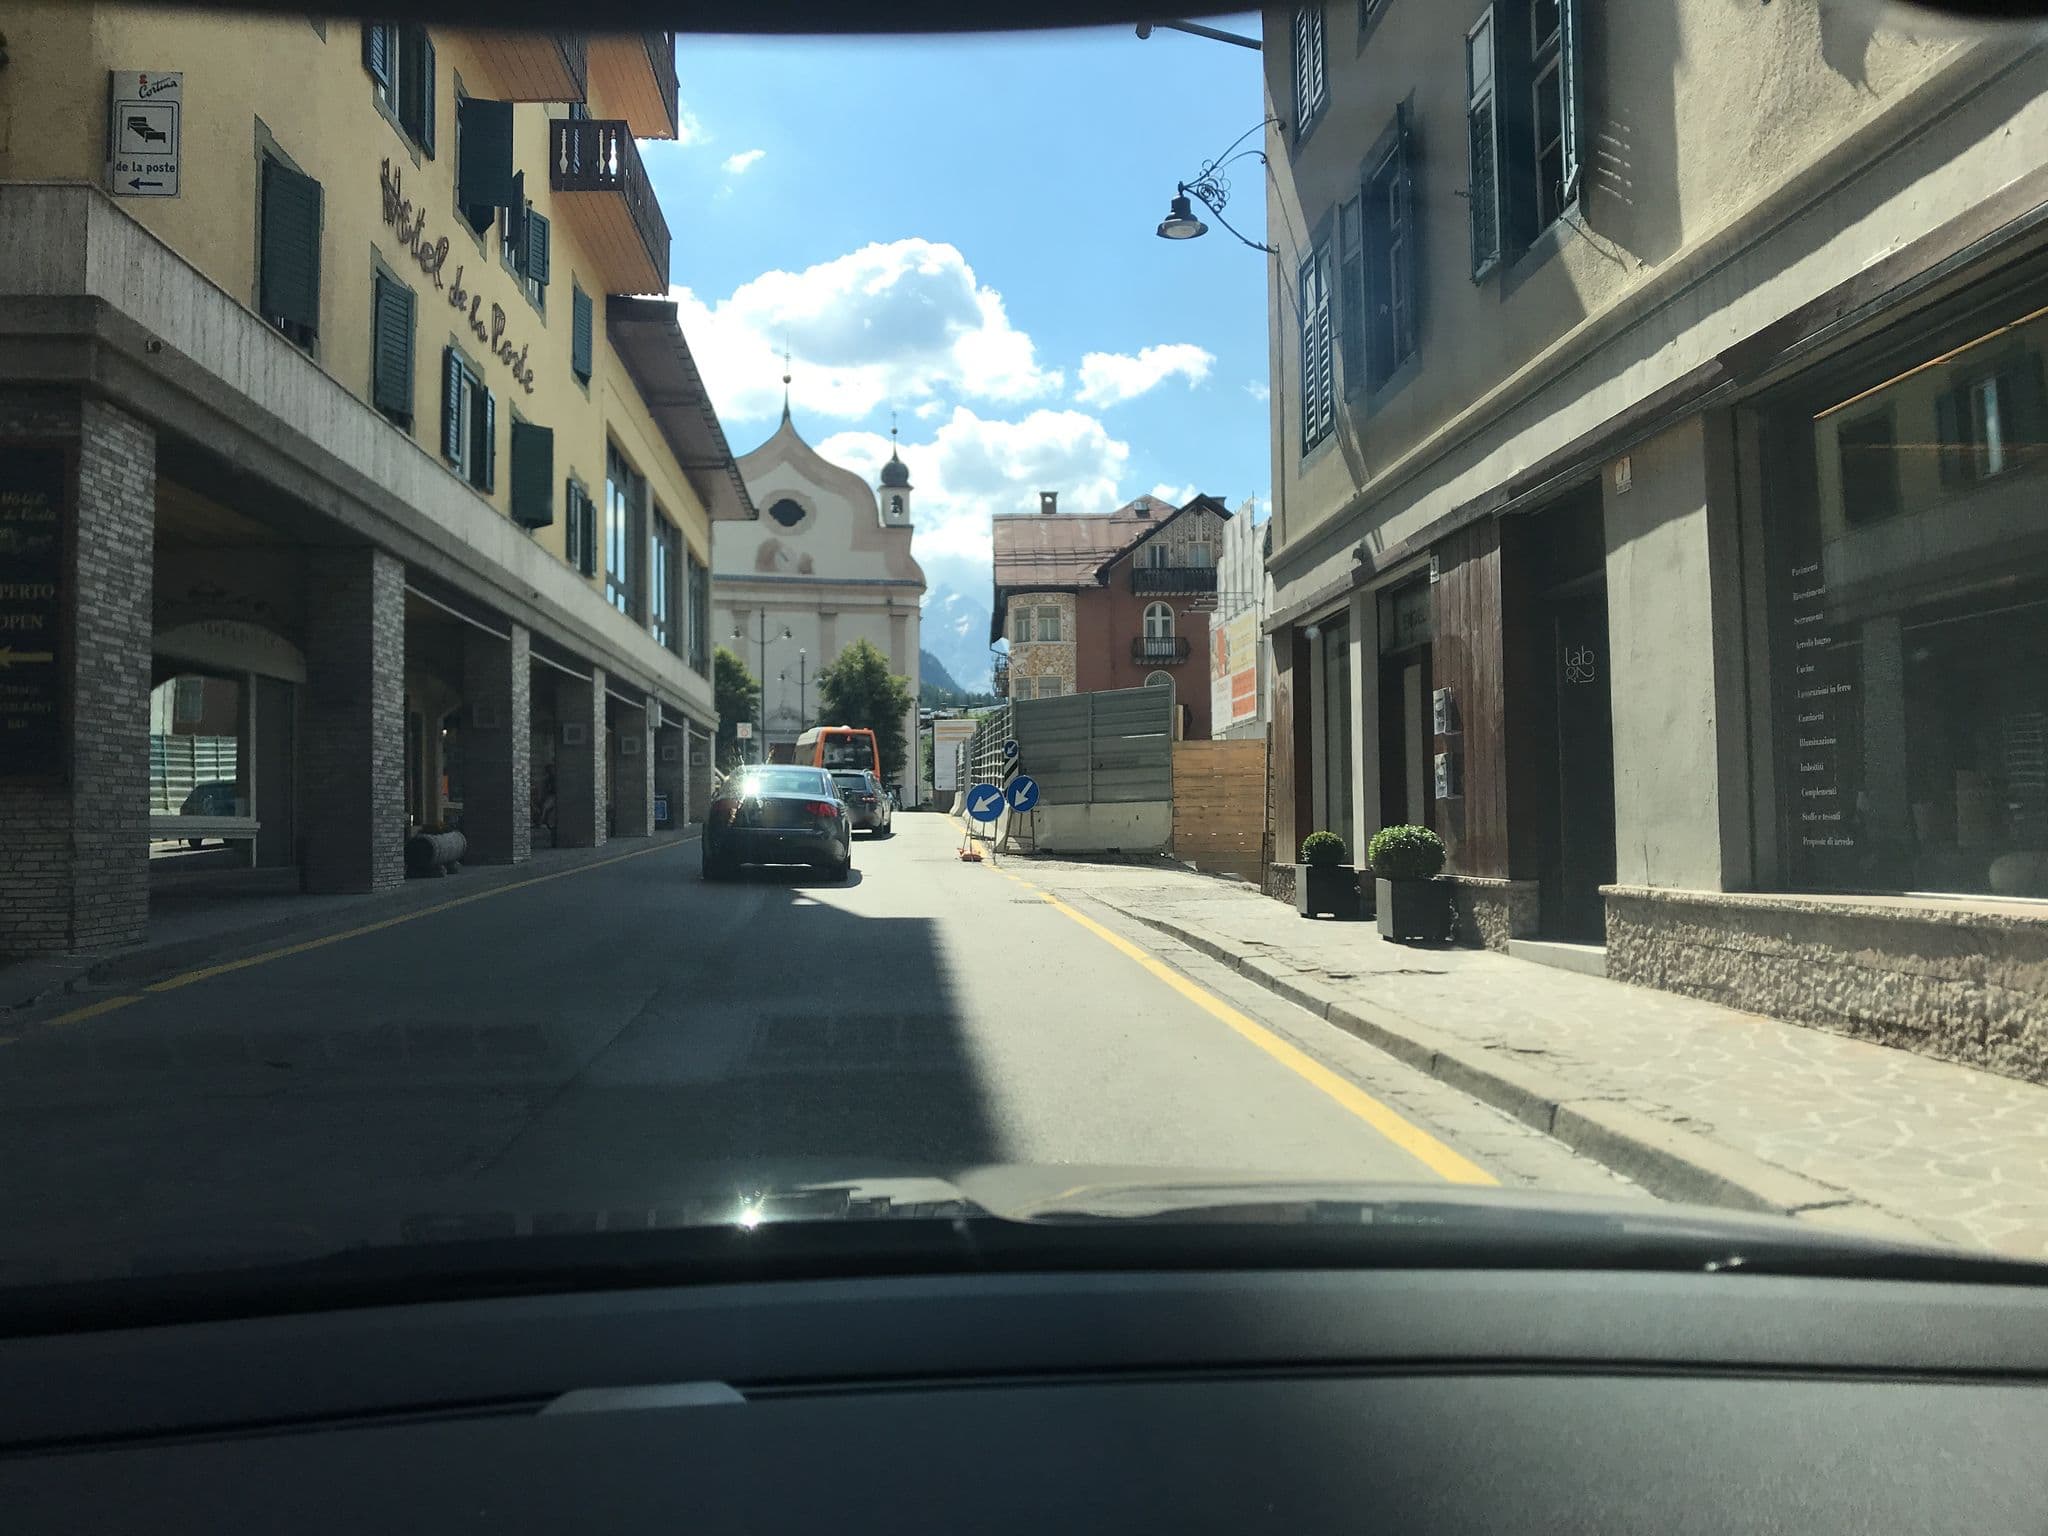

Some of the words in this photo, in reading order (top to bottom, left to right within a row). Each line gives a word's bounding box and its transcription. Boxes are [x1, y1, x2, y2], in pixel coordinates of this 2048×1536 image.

[138, 77, 178, 99] Cortina
[115, 161, 129, 172] de
[132, 161, 143, 172] la
[146, 161, 176, 175] poste
[448, 265, 467, 312] de
[491, 302, 534, 394] Poste
[1565, 645, 1595, 667] lab
